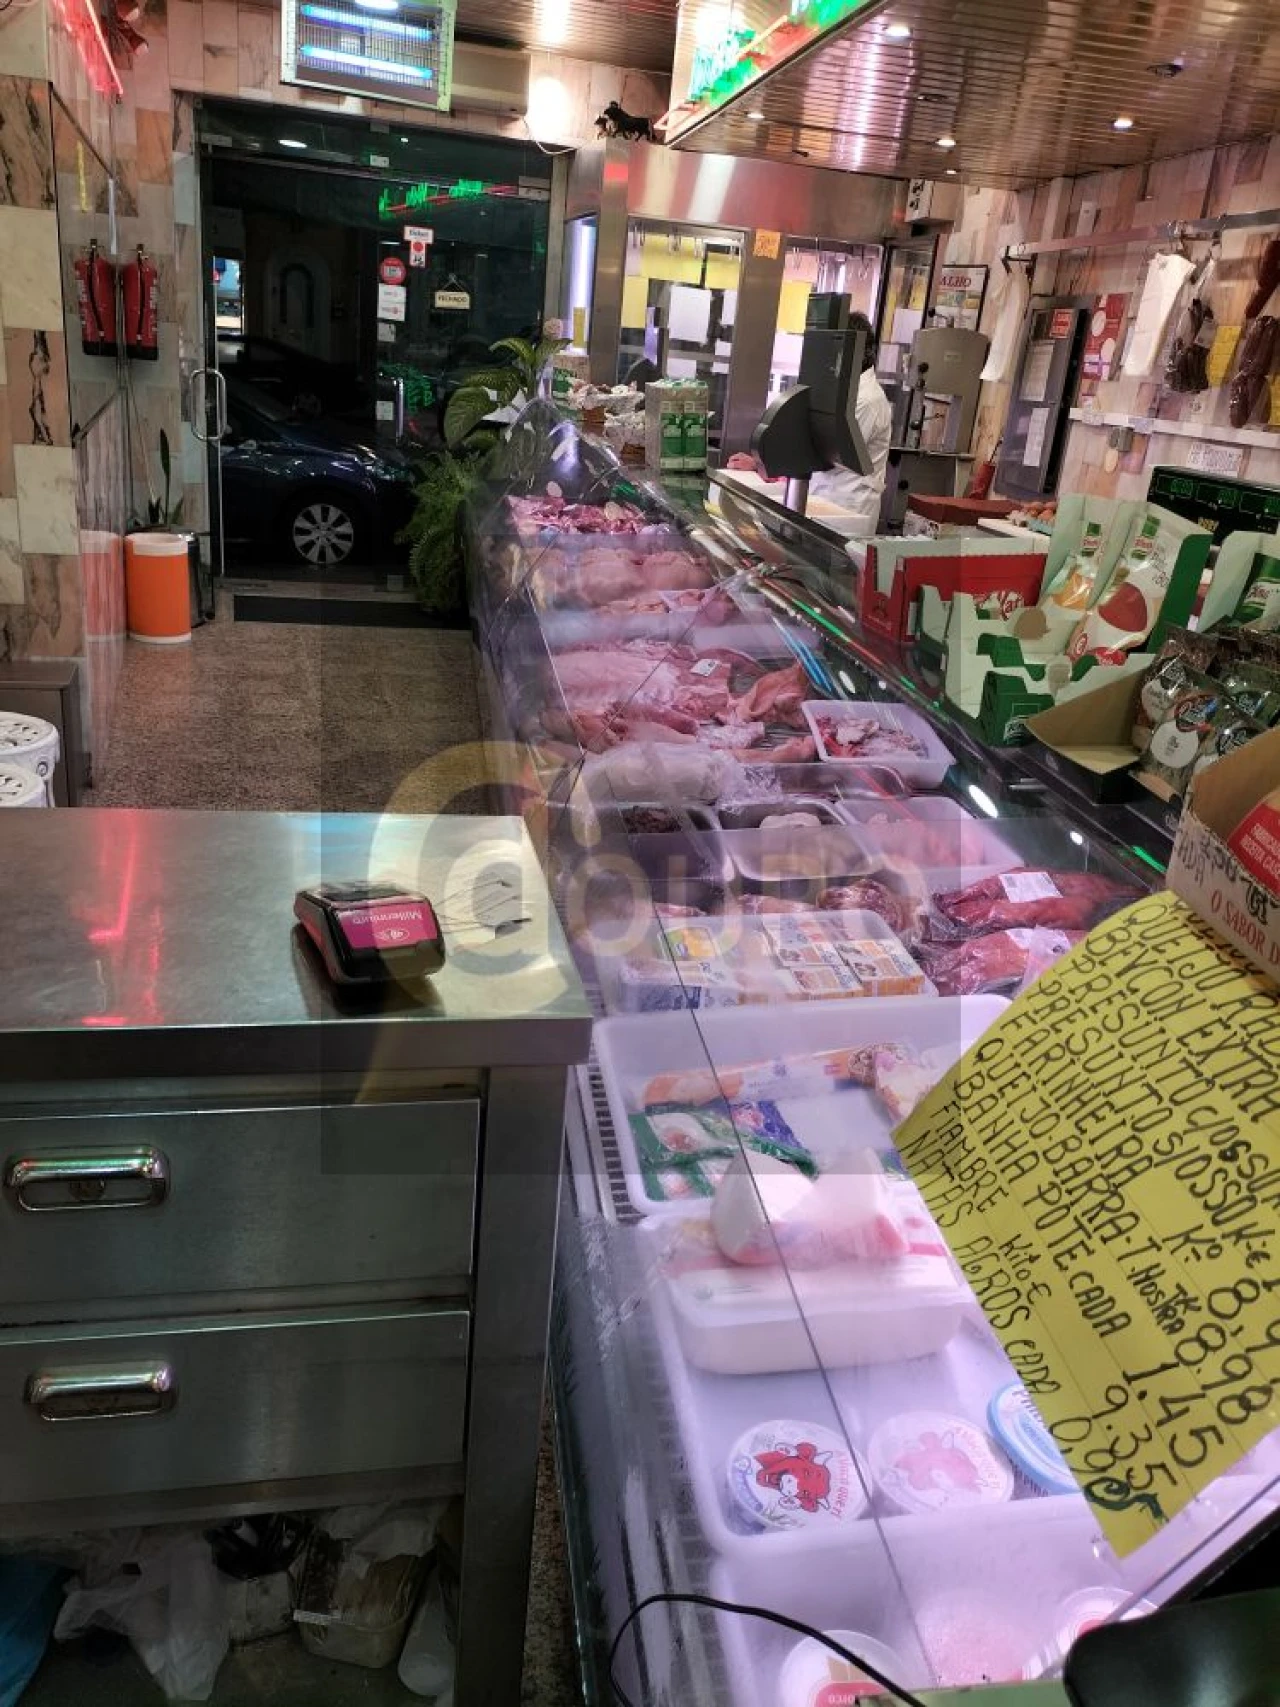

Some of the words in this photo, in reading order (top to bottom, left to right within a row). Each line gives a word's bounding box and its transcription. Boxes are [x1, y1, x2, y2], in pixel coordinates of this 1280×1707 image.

[1123, 905, 1247, 992] QUEIJO
[1224, 900, 1266, 957] SABOR
[1000, 1012, 1156, 1193] FARINHEIRA
[1026, 980, 1173, 1139] PRESUNTO
[1059, 951, 1216, 1111] PRESUNTO
[1176, 1009, 1280, 1123] EXTRA
[897, 1130, 978, 1227] NATAS
[952, 1236, 1031, 1330] AGROS
[1001, 1340, 1061, 1394] CADA
[930, 1100, 1008, 1214] FIAMBRE
[1089, 1384, 1178, 1507] 9.35
[952, 1070, 1040, 1185] BANHA
[1022, 1181, 1096, 1272] POTE
[1068, 1270, 1132, 1338] CADA
[1122, 1354, 1224, 1468] 1.45
